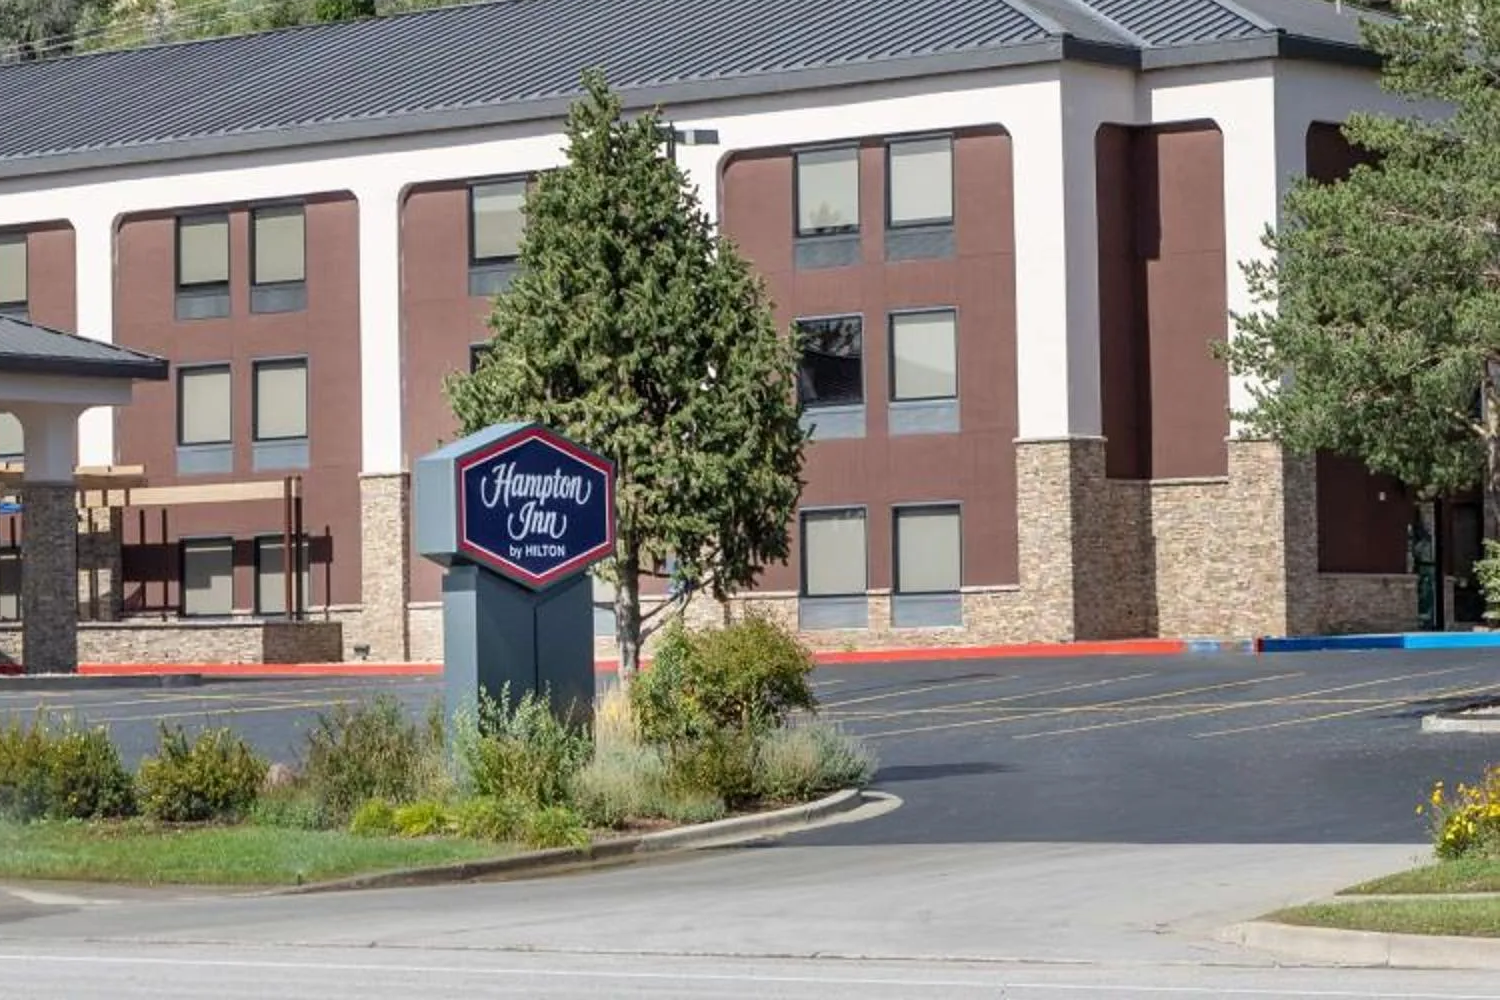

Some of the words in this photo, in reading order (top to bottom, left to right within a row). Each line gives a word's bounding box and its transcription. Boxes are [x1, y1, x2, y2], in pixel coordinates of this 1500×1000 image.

[481, 461, 592, 508] Hampton
[507, 500, 567, 540] Inn
[509, 544, 522, 560] by
[525, 544, 565, 557] HILTON
